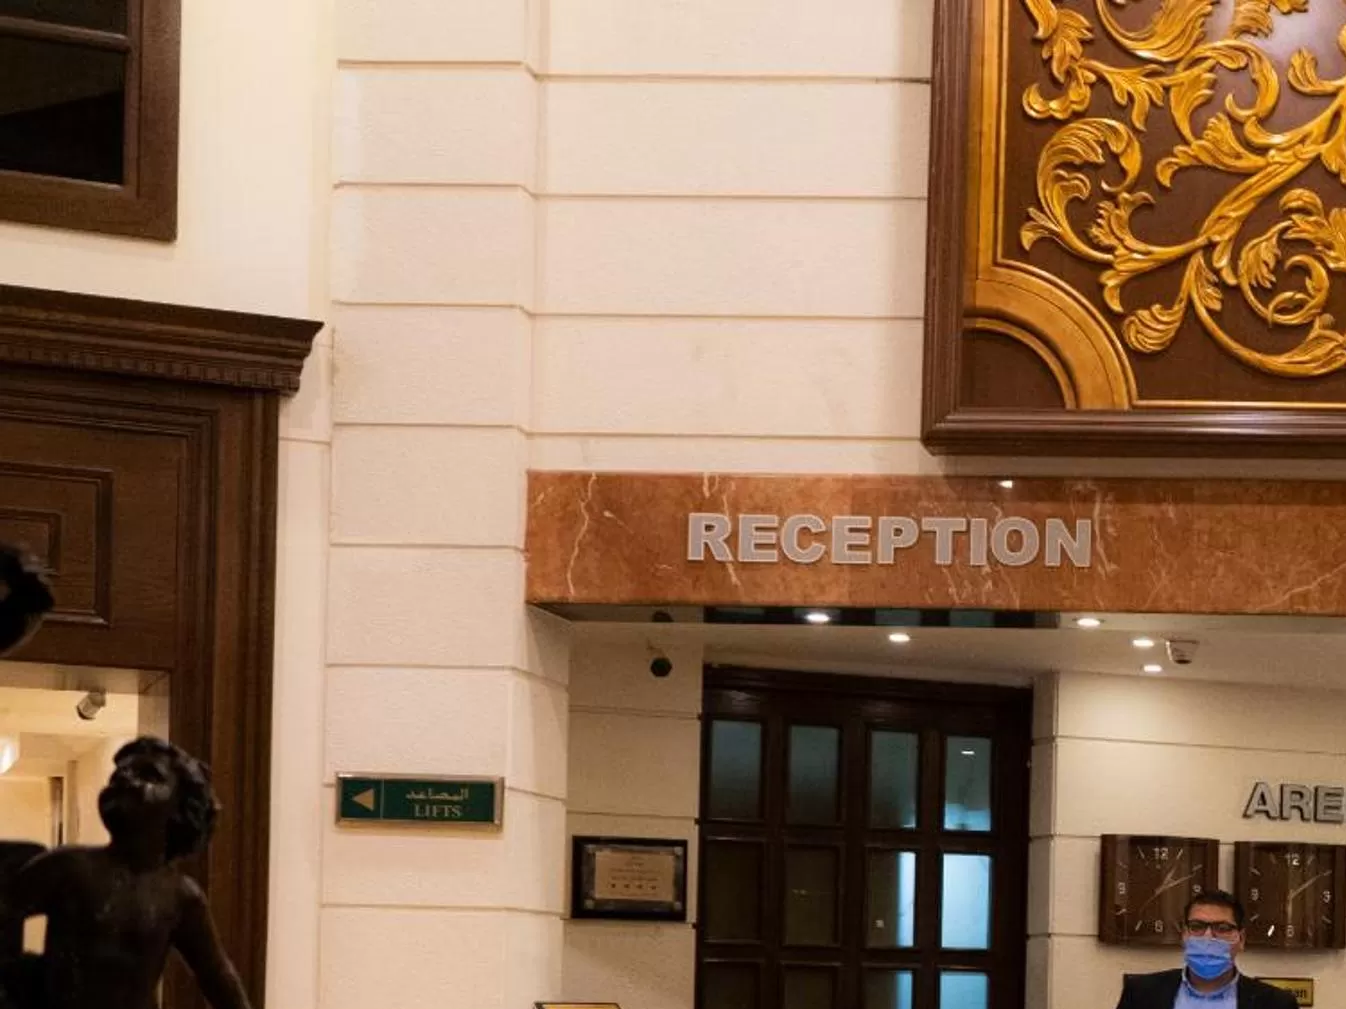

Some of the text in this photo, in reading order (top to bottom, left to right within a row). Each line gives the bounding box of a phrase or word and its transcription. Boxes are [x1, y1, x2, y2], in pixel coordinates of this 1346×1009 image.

[686, 512, 1093, 568] RECEPTION
[414, 804, 463, 818] LIFTS
[1153, 847, 1169, 861] 12
[1285, 852, 1300, 867] 12
[1322, 890, 1332, 904] 3
